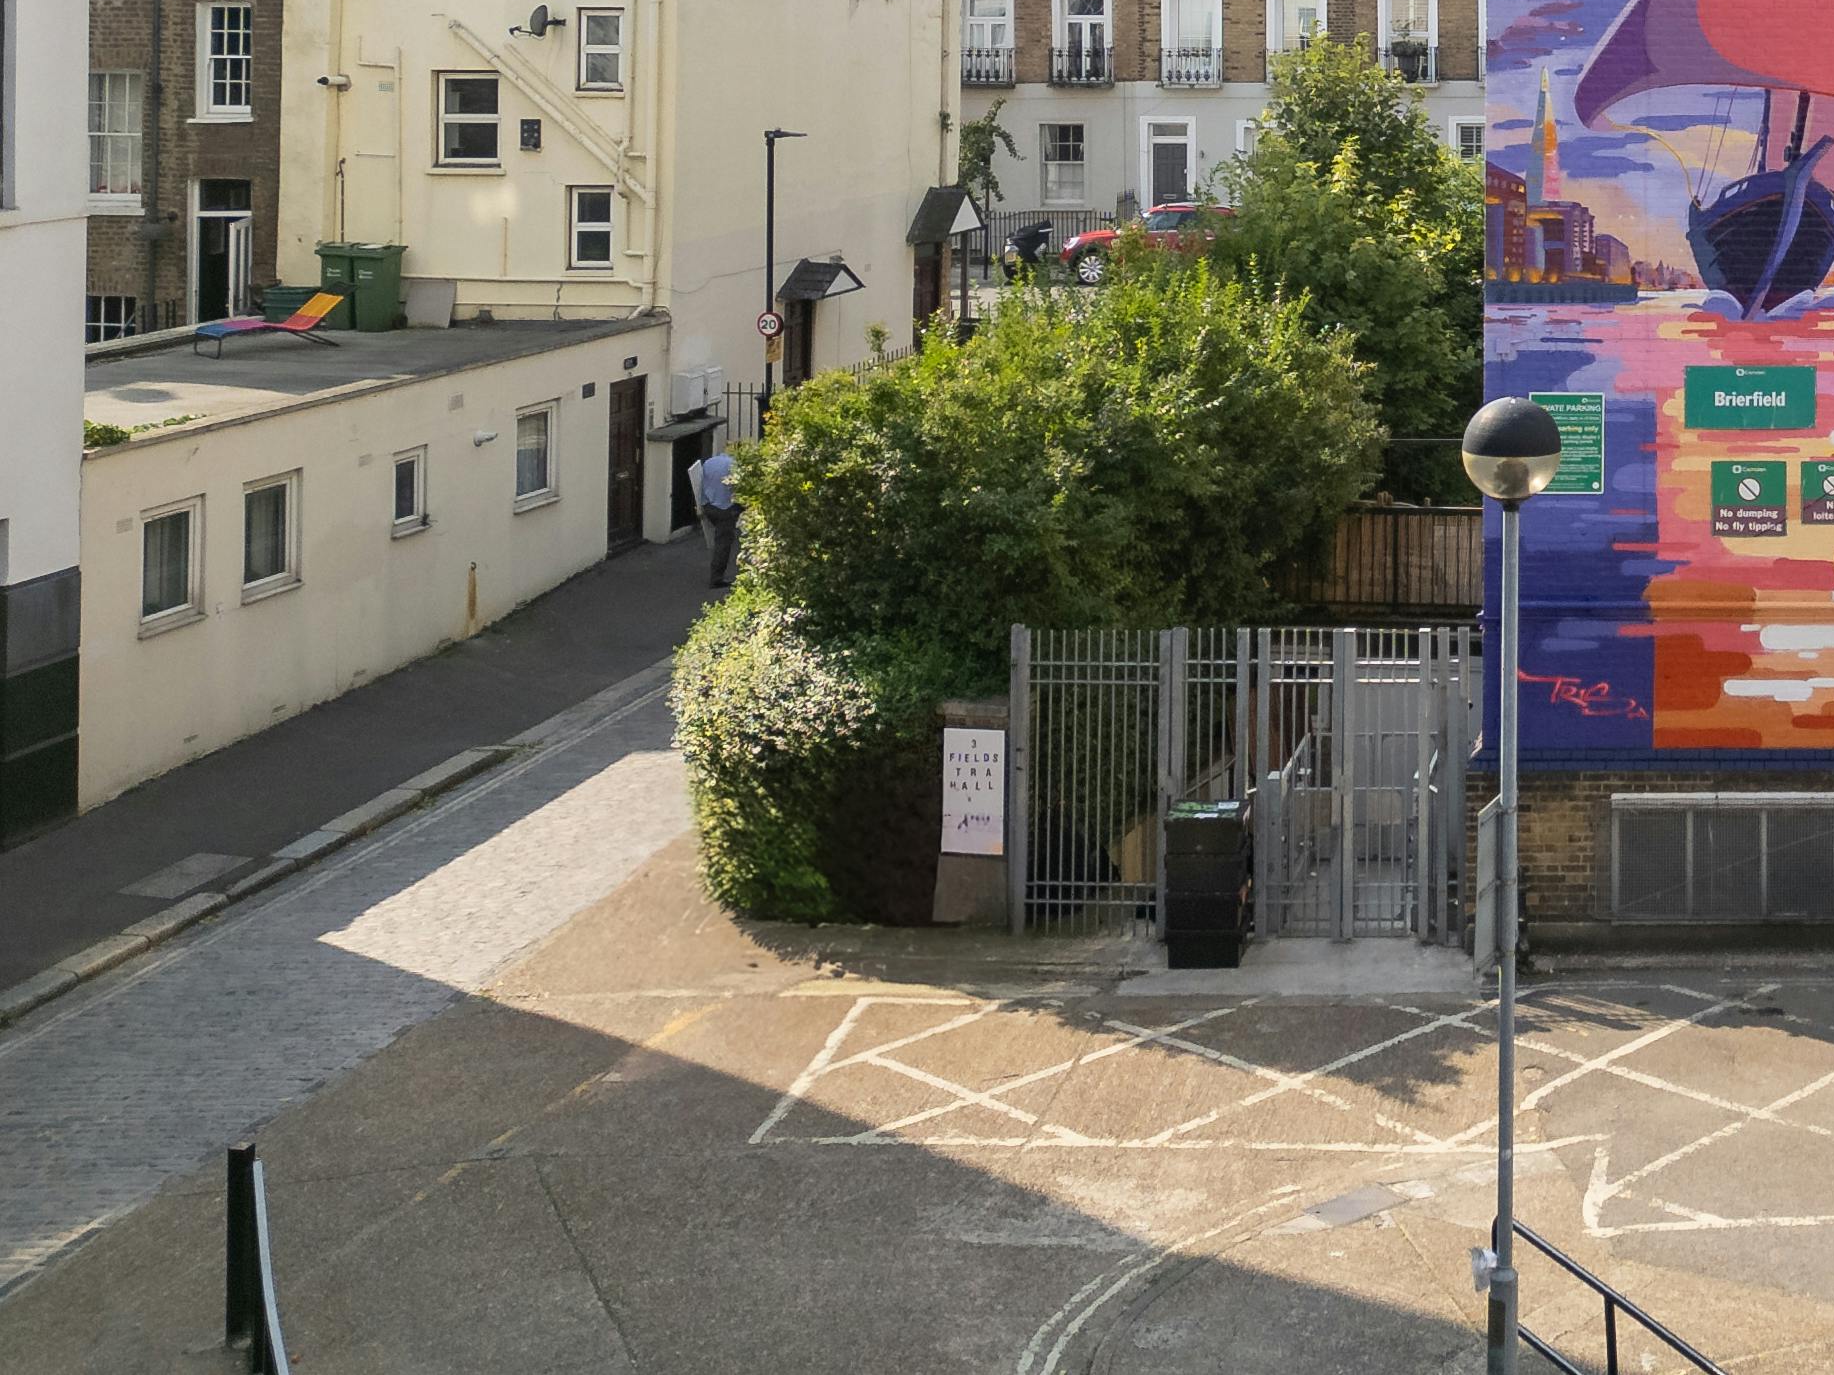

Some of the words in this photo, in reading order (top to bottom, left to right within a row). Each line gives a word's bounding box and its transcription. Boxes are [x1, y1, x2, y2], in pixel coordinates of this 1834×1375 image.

[761, 319, 777, 330] 20
[1714, 391, 1786, 407] Brierfield
[1720, 508, 1734, 518] No
[1737, 508, 1779, 520] dumping
[1715, 521, 1730, 531] No
[1732, 521, 1745, 532] fly
[1748, 521, 1783, 532] tipping
[971, 739, 977, 749] 3
[949, 753, 998, 763] FIELDS
[956, 767, 992, 777] TRA
[950, 781, 993, 790] HALL
